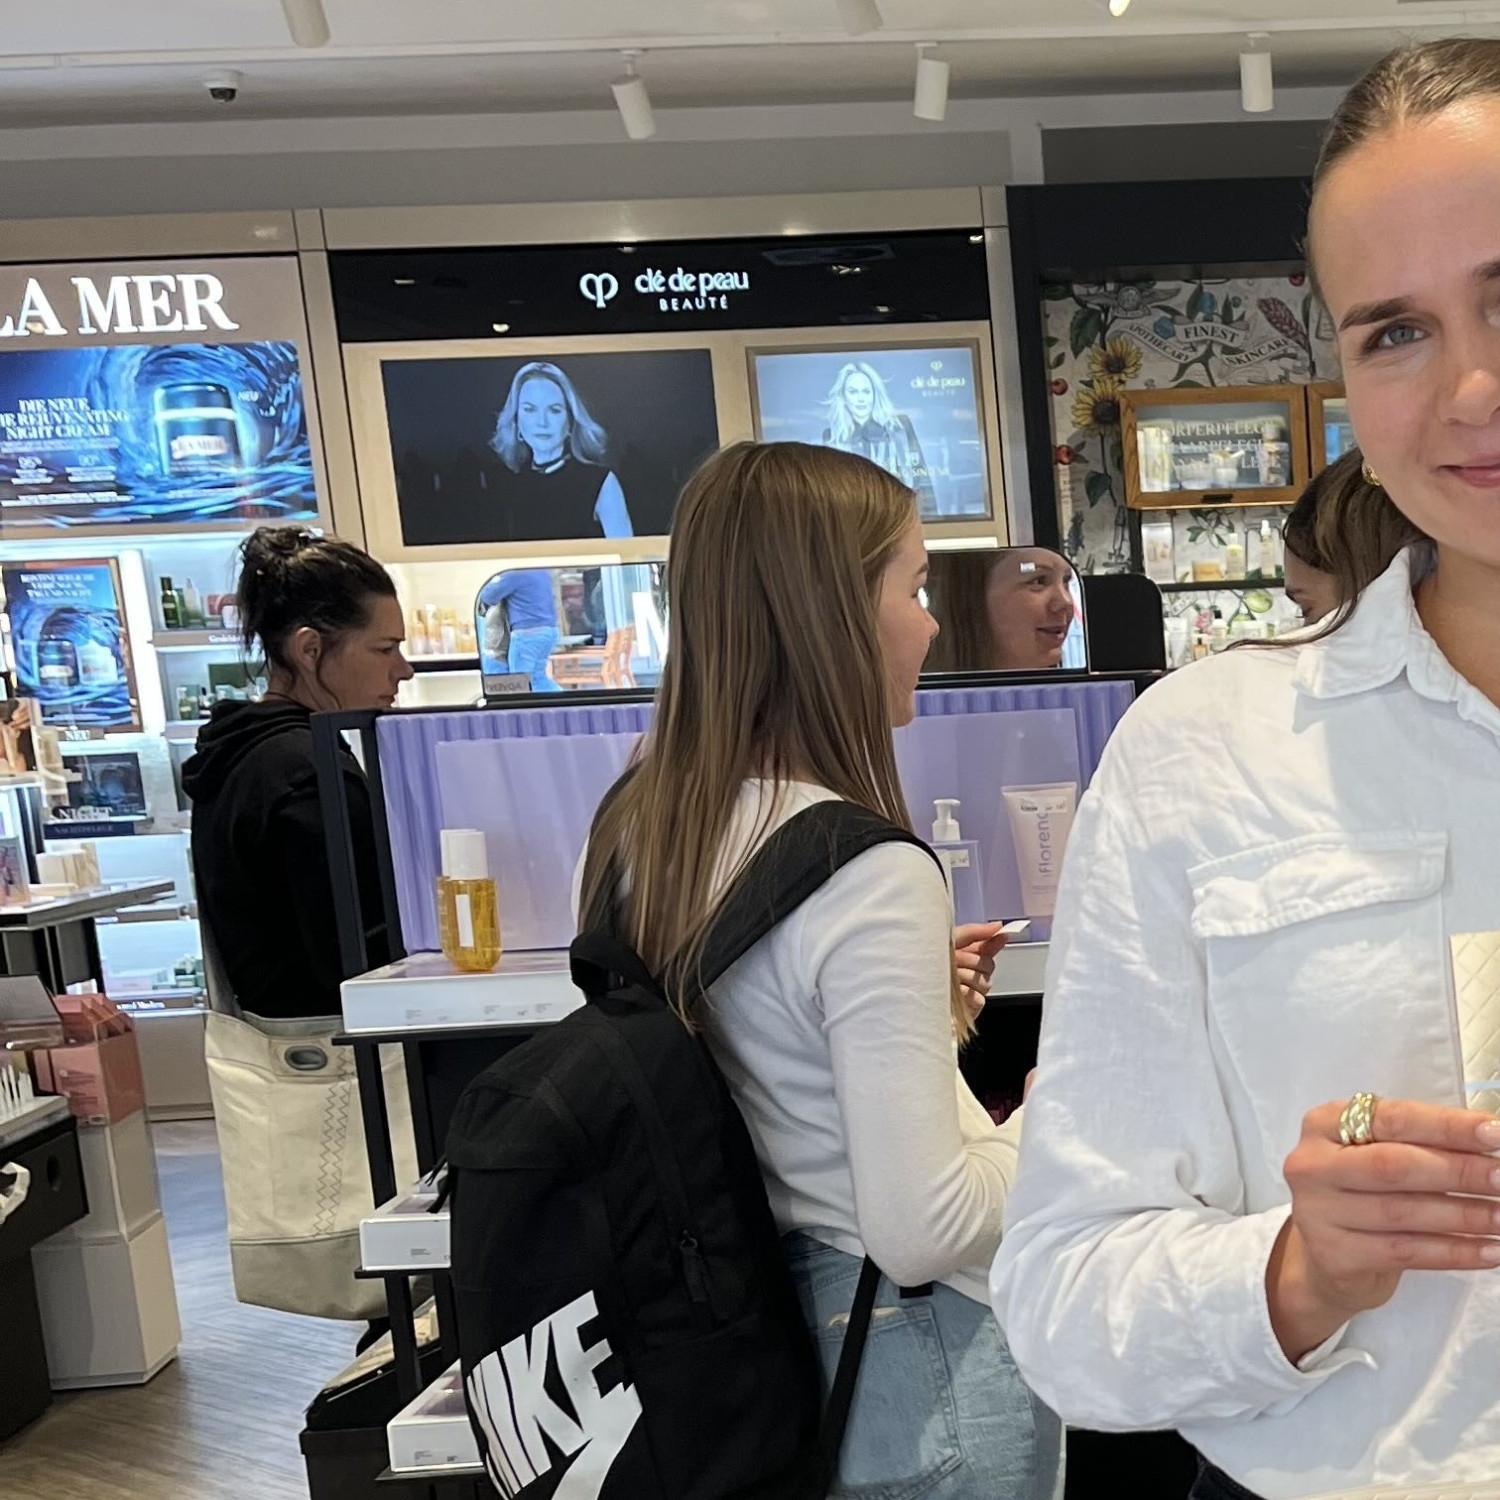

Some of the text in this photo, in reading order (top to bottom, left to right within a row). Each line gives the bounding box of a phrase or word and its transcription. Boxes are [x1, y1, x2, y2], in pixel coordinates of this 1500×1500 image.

[634, 266, 750, 298] clé de peau
[0, 273, 240, 337] A MER
[659, 294, 729, 312] BEAUTÉ
[1129, 324, 1192, 363] APOTHECARY
[1184, 327, 1240, 344] FINEST
[466, 1290, 634, 1500] NIKE
